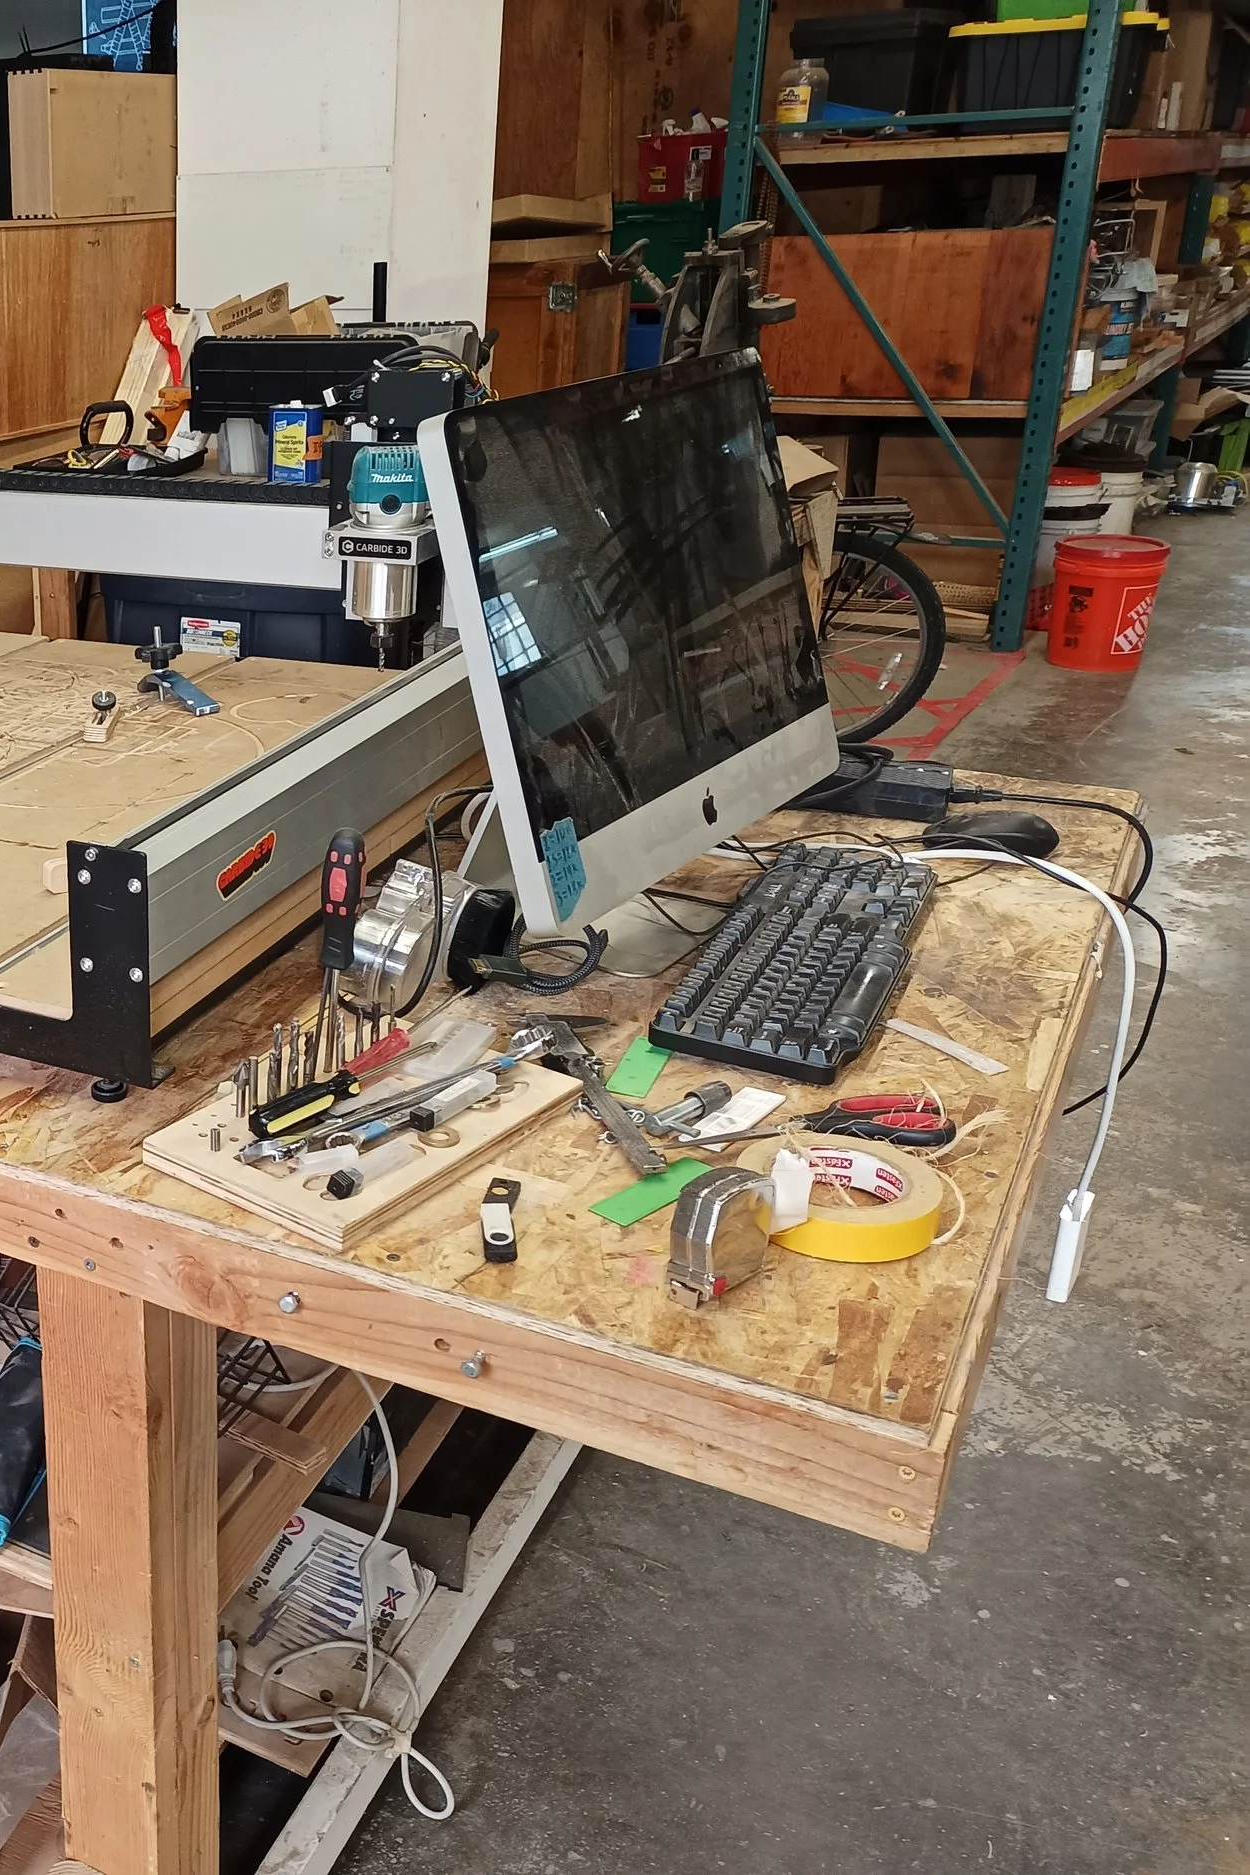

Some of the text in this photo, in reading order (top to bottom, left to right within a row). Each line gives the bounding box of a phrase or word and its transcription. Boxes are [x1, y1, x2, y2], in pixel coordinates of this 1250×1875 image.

[355, 543, 408, 555] CARBIDE 3D
[245, 1533, 293, 1602] Amana Tool
